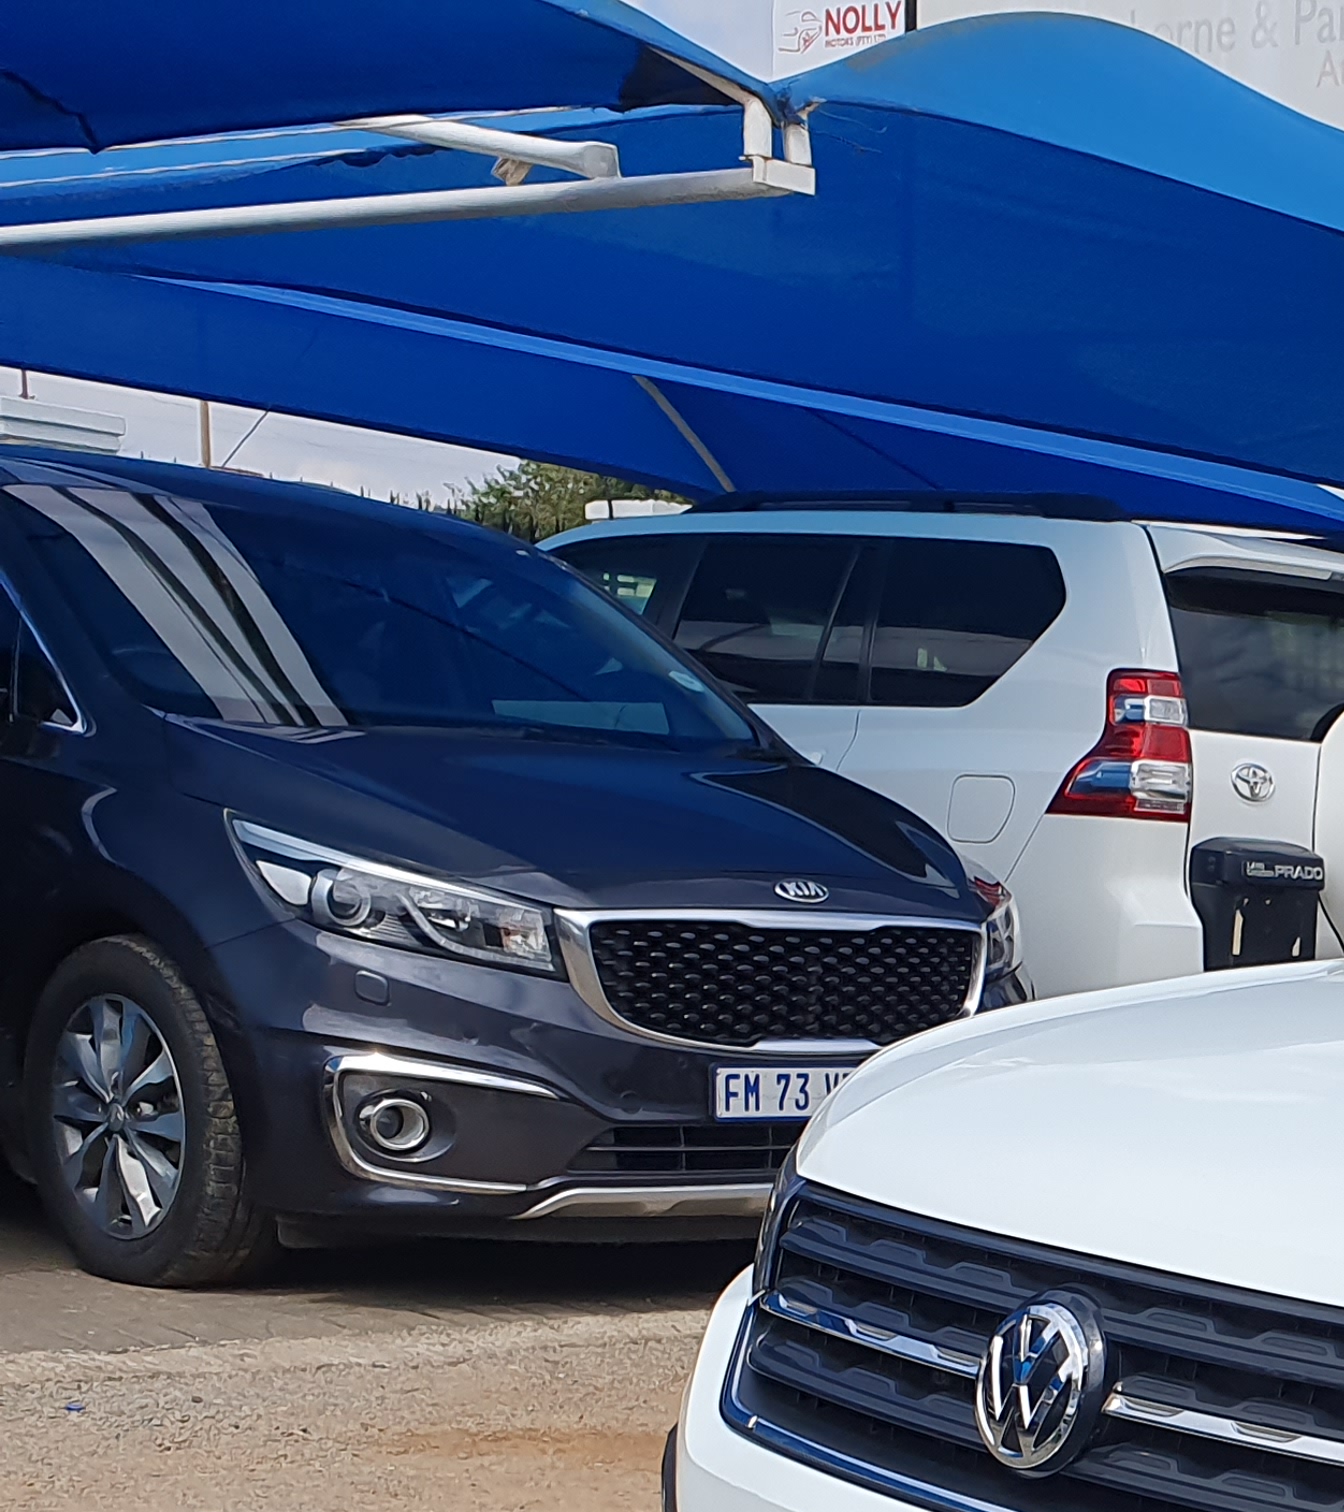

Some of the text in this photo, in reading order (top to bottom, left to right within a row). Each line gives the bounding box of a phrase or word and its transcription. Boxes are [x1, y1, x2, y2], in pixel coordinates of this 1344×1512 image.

[824, 0, 902, 37] NOLLY
[1251, 0, 1279, 49] &
[780, 880, 826, 899] KIA
[1274, 865, 1324, 880] PRADO
[724, 1073, 760, 1112] FM
[776, 1073, 810, 1111] 73
